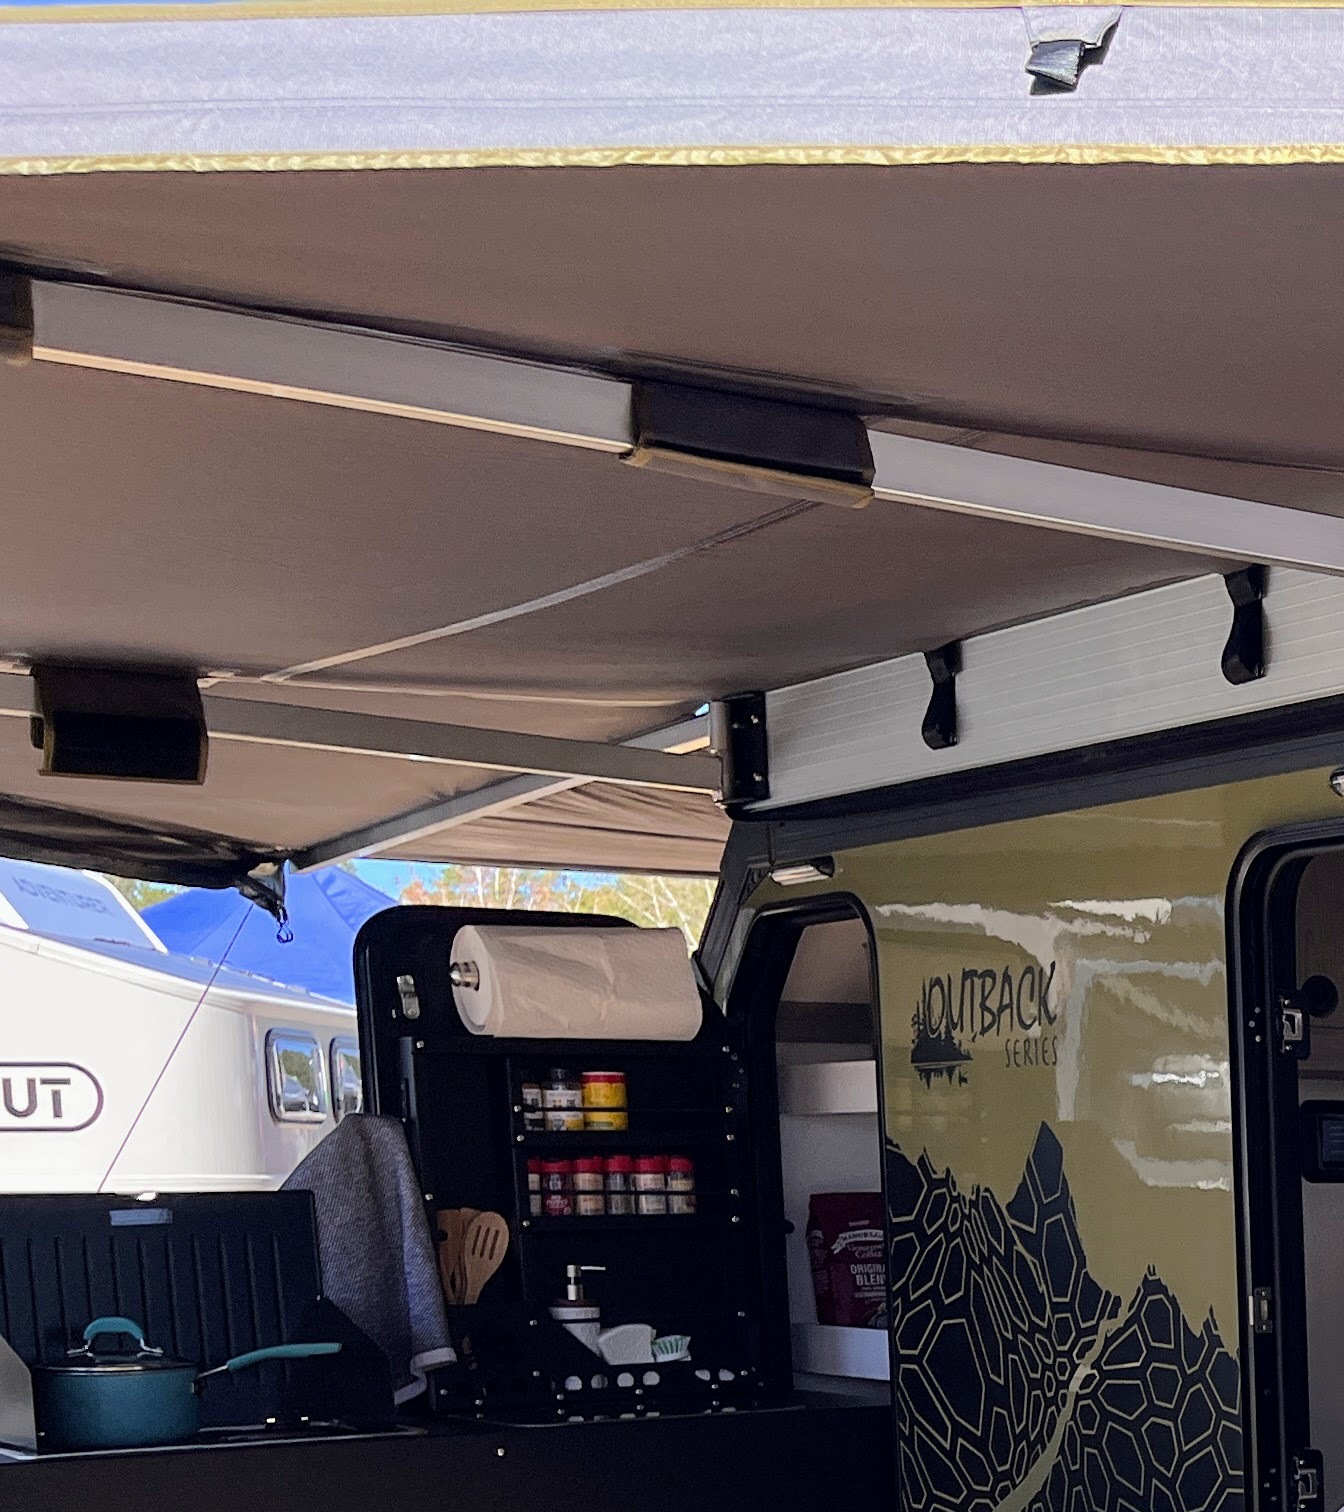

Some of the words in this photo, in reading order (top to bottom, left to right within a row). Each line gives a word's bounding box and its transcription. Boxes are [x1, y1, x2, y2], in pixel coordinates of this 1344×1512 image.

[926, 961, 1057, 1037] OUTBACK
[1004, 1035, 1058, 1068] SERIES
[1, 1076, 71, 1119] UT
